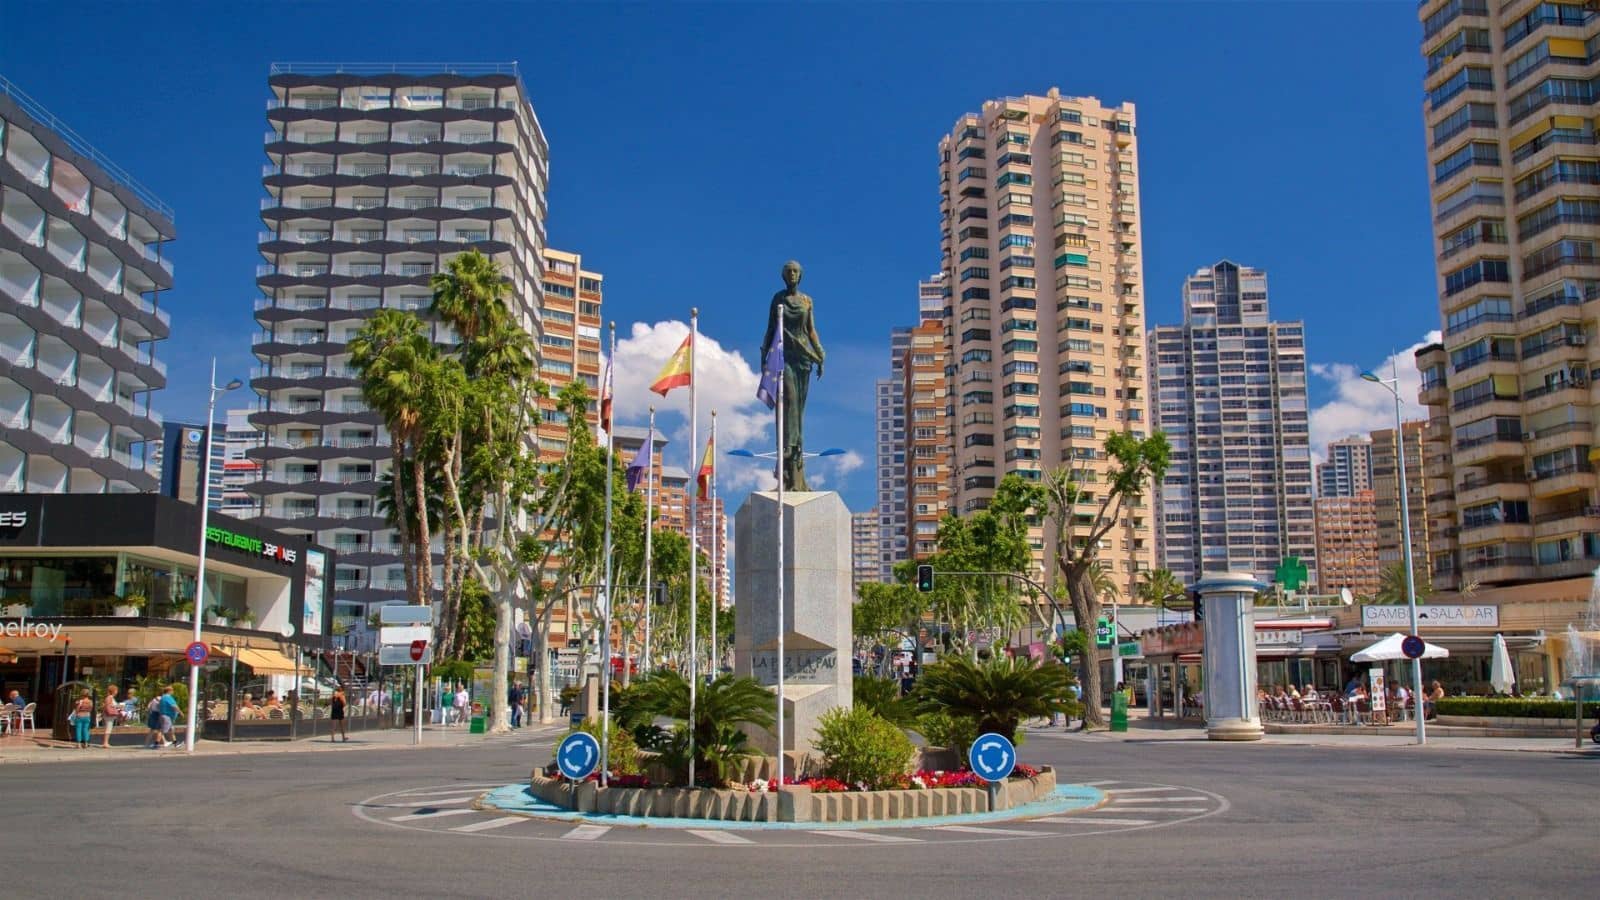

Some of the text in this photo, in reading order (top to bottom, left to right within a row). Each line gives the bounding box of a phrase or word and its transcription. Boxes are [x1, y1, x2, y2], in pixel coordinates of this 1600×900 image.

[1430, 607, 1493, 619] SALADAR
[753, 657, 767, 668] LA
[771, 657, 792, 668] PZ
[798, 656, 813, 668] LA
